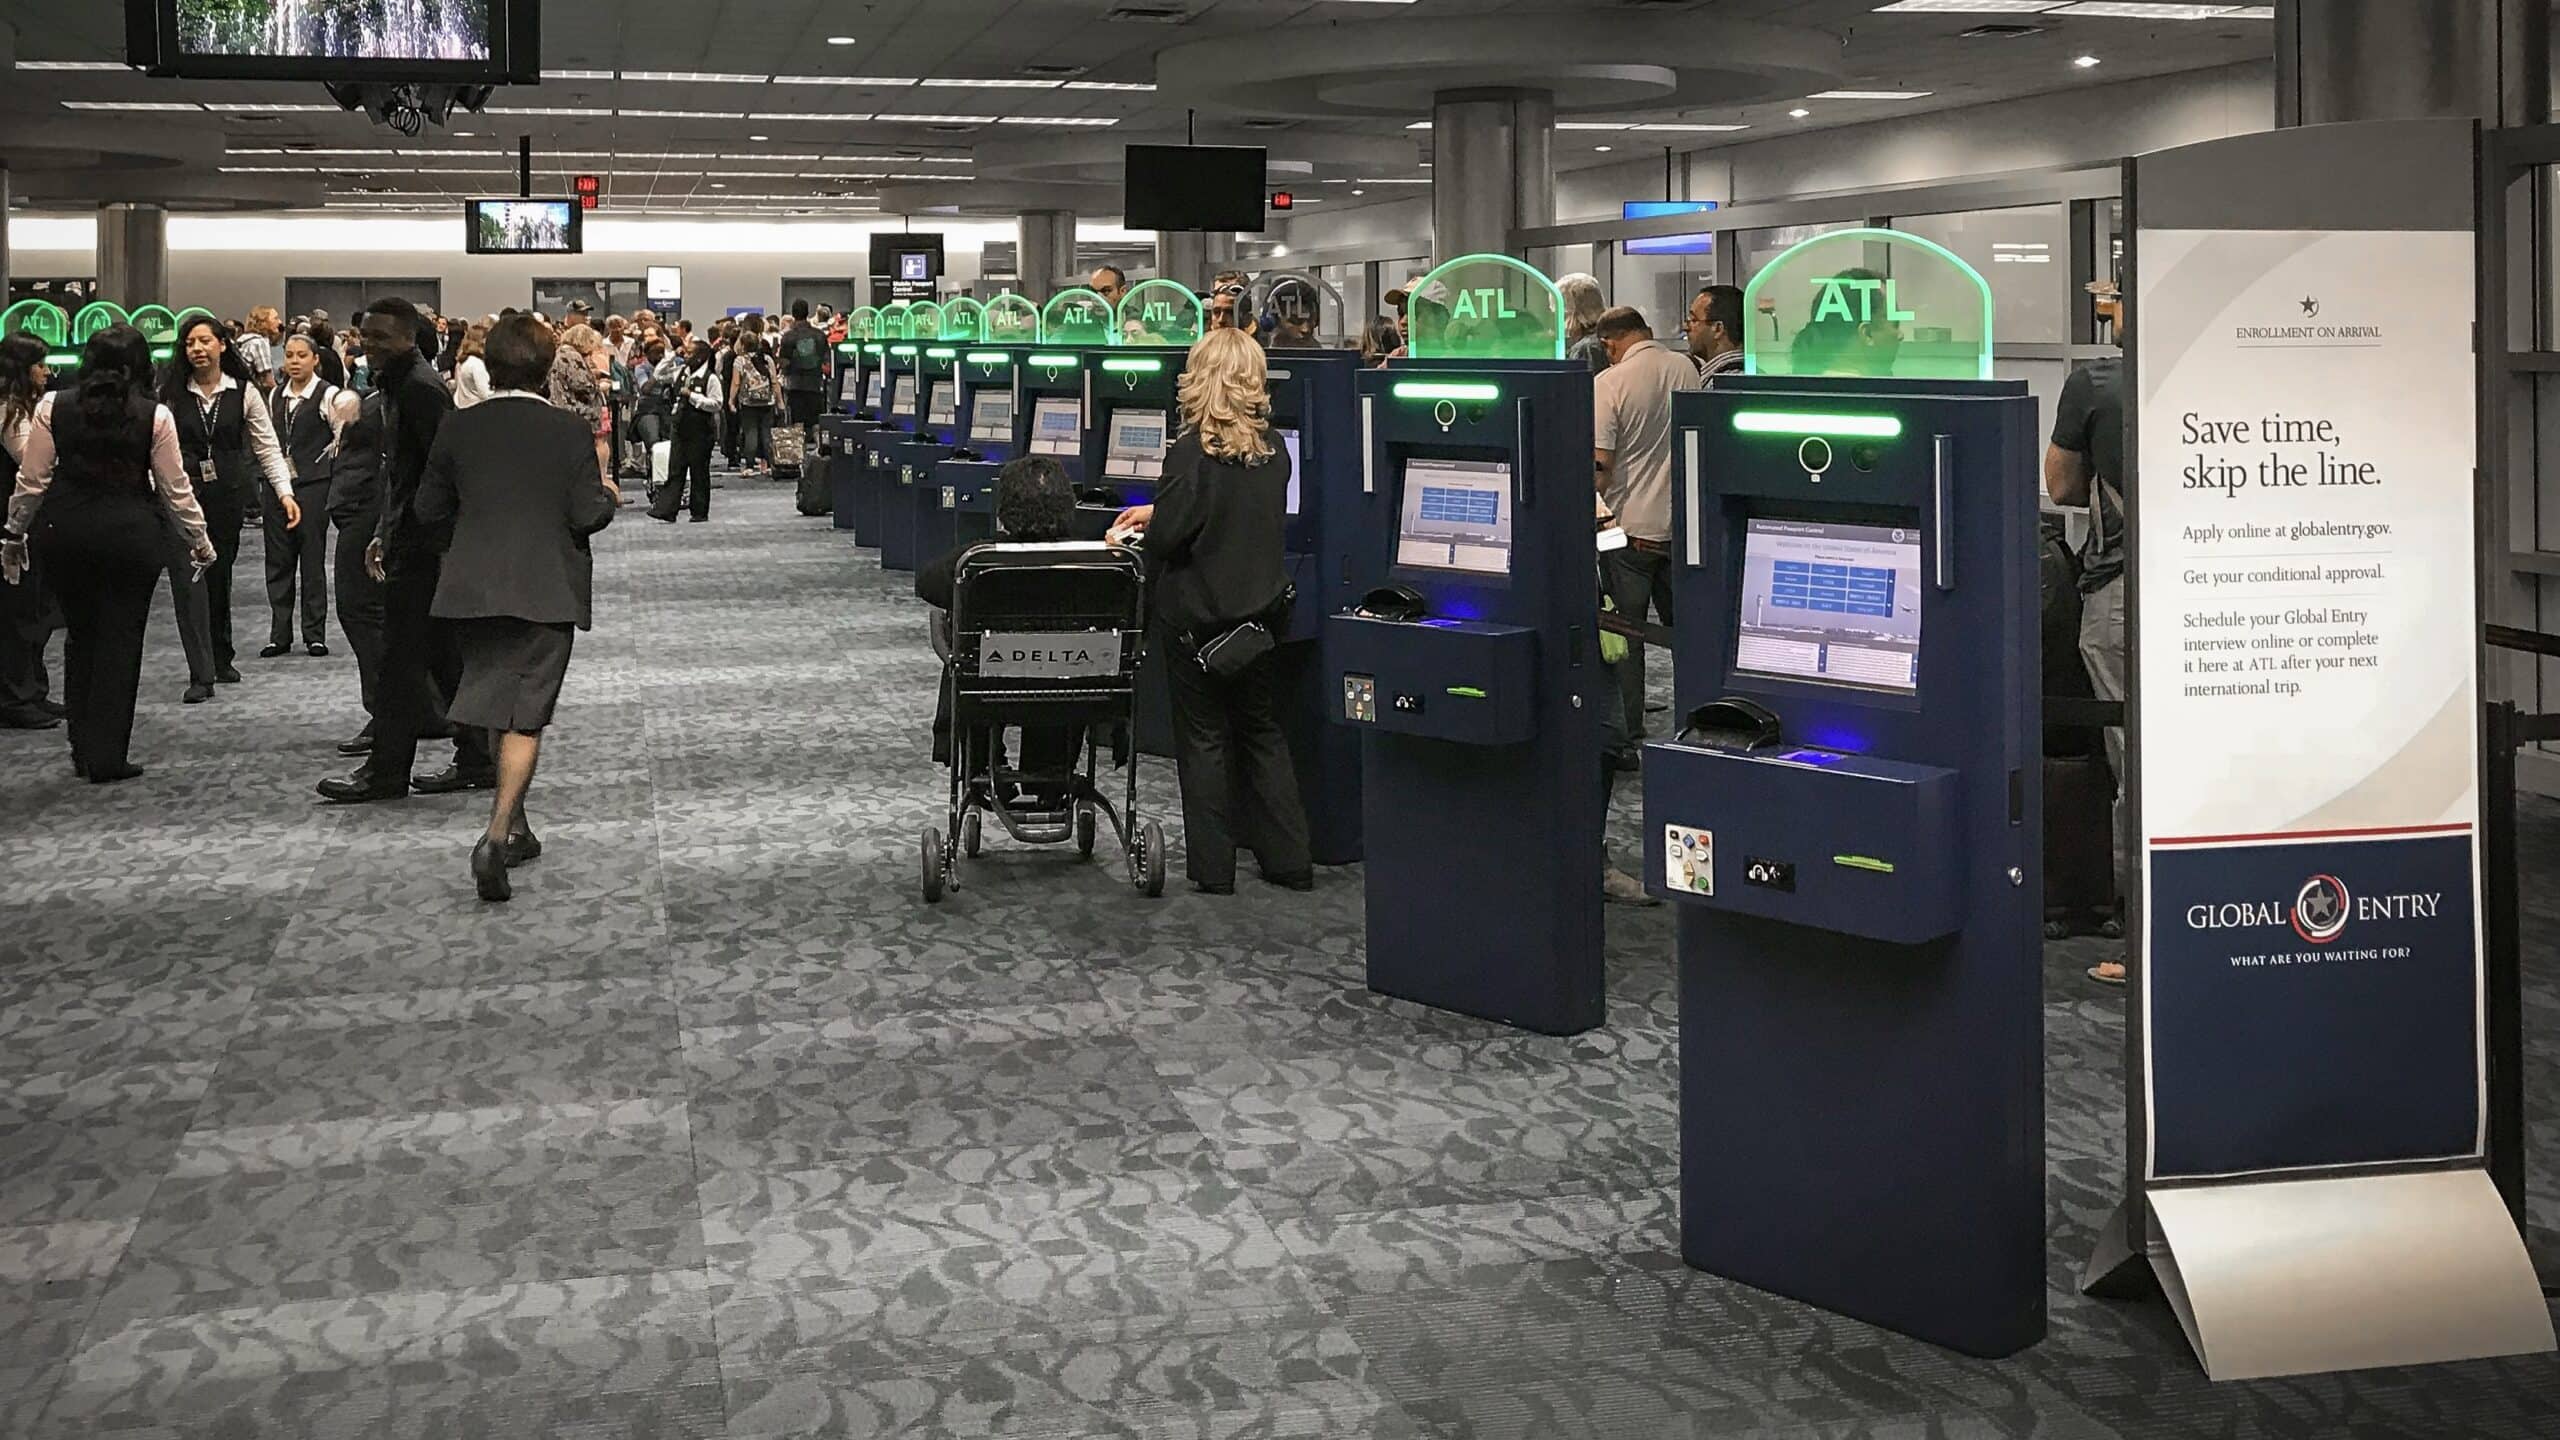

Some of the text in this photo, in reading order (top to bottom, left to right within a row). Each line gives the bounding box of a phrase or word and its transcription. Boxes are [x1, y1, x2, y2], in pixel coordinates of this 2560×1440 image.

[1268, 296, 1310, 318] ATL
[1453, 288, 1517, 319] ATL
[1810, 278, 1916, 322] ATL
[886, 315, 902, 326] ATL
[915, 314, 934, 325] ATL
[953, 312, 974, 325] ATL
[996, 311, 1021, 326] ATL
[1063, 307, 1092, 324] ATL
[1142, 302, 1176, 322] ATL
[21, 315, 50, 330] ATL
[144, 317, 164, 329] ATL
[858, 317, 874, 328] ATL
[2236, 326, 2382, 338] ENROLLMENT ON ARRIVAL
[2182, 412, 2341, 447] Save time,
[2182, 451, 2382, 498] skip the line.
[2183, 521, 2392, 543] Apply online at globalentry.gov.
[2183, 563, 2384, 587] Get your conditional approval.
[2183, 608, 2368, 630] Schedule your Global Entry
[2184, 631, 2379, 652] interview online or complete
[1013, 650, 1089, 662] DELTA
[2184, 655, 2378, 673] it here at ATL after your next
[2184, 679, 2302, 697] international trip.
[2186, 893, 2441, 929] GLOBAL ENTRY
[2230, 947, 2411, 967] WHAT ARE YOU WAITING FOR?
